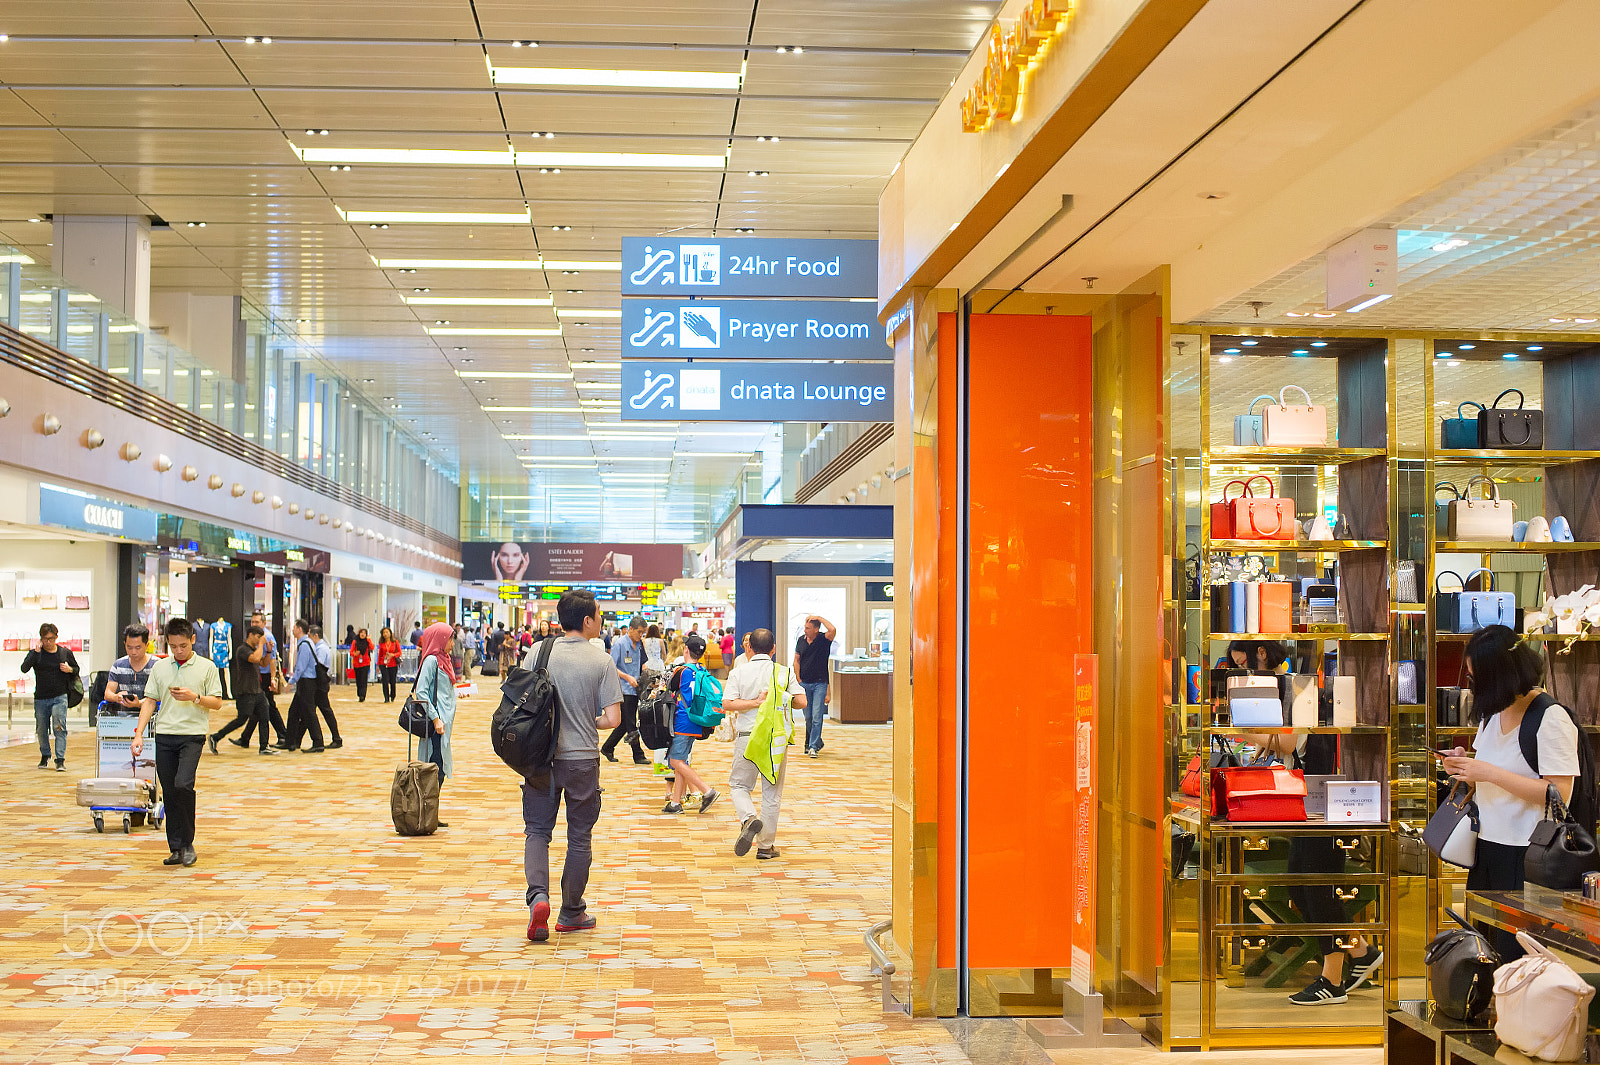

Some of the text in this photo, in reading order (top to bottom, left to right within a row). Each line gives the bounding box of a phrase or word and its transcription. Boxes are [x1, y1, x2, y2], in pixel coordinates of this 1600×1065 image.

[728, 256, 841, 276] 24hr Food
[728, 318, 799, 342] Prayer
[805, 319, 870, 339] Room
[685, 385, 716, 394] dnata
[730, 380, 886, 406] dnata Lounge
[84, 503, 124, 530] COACH
